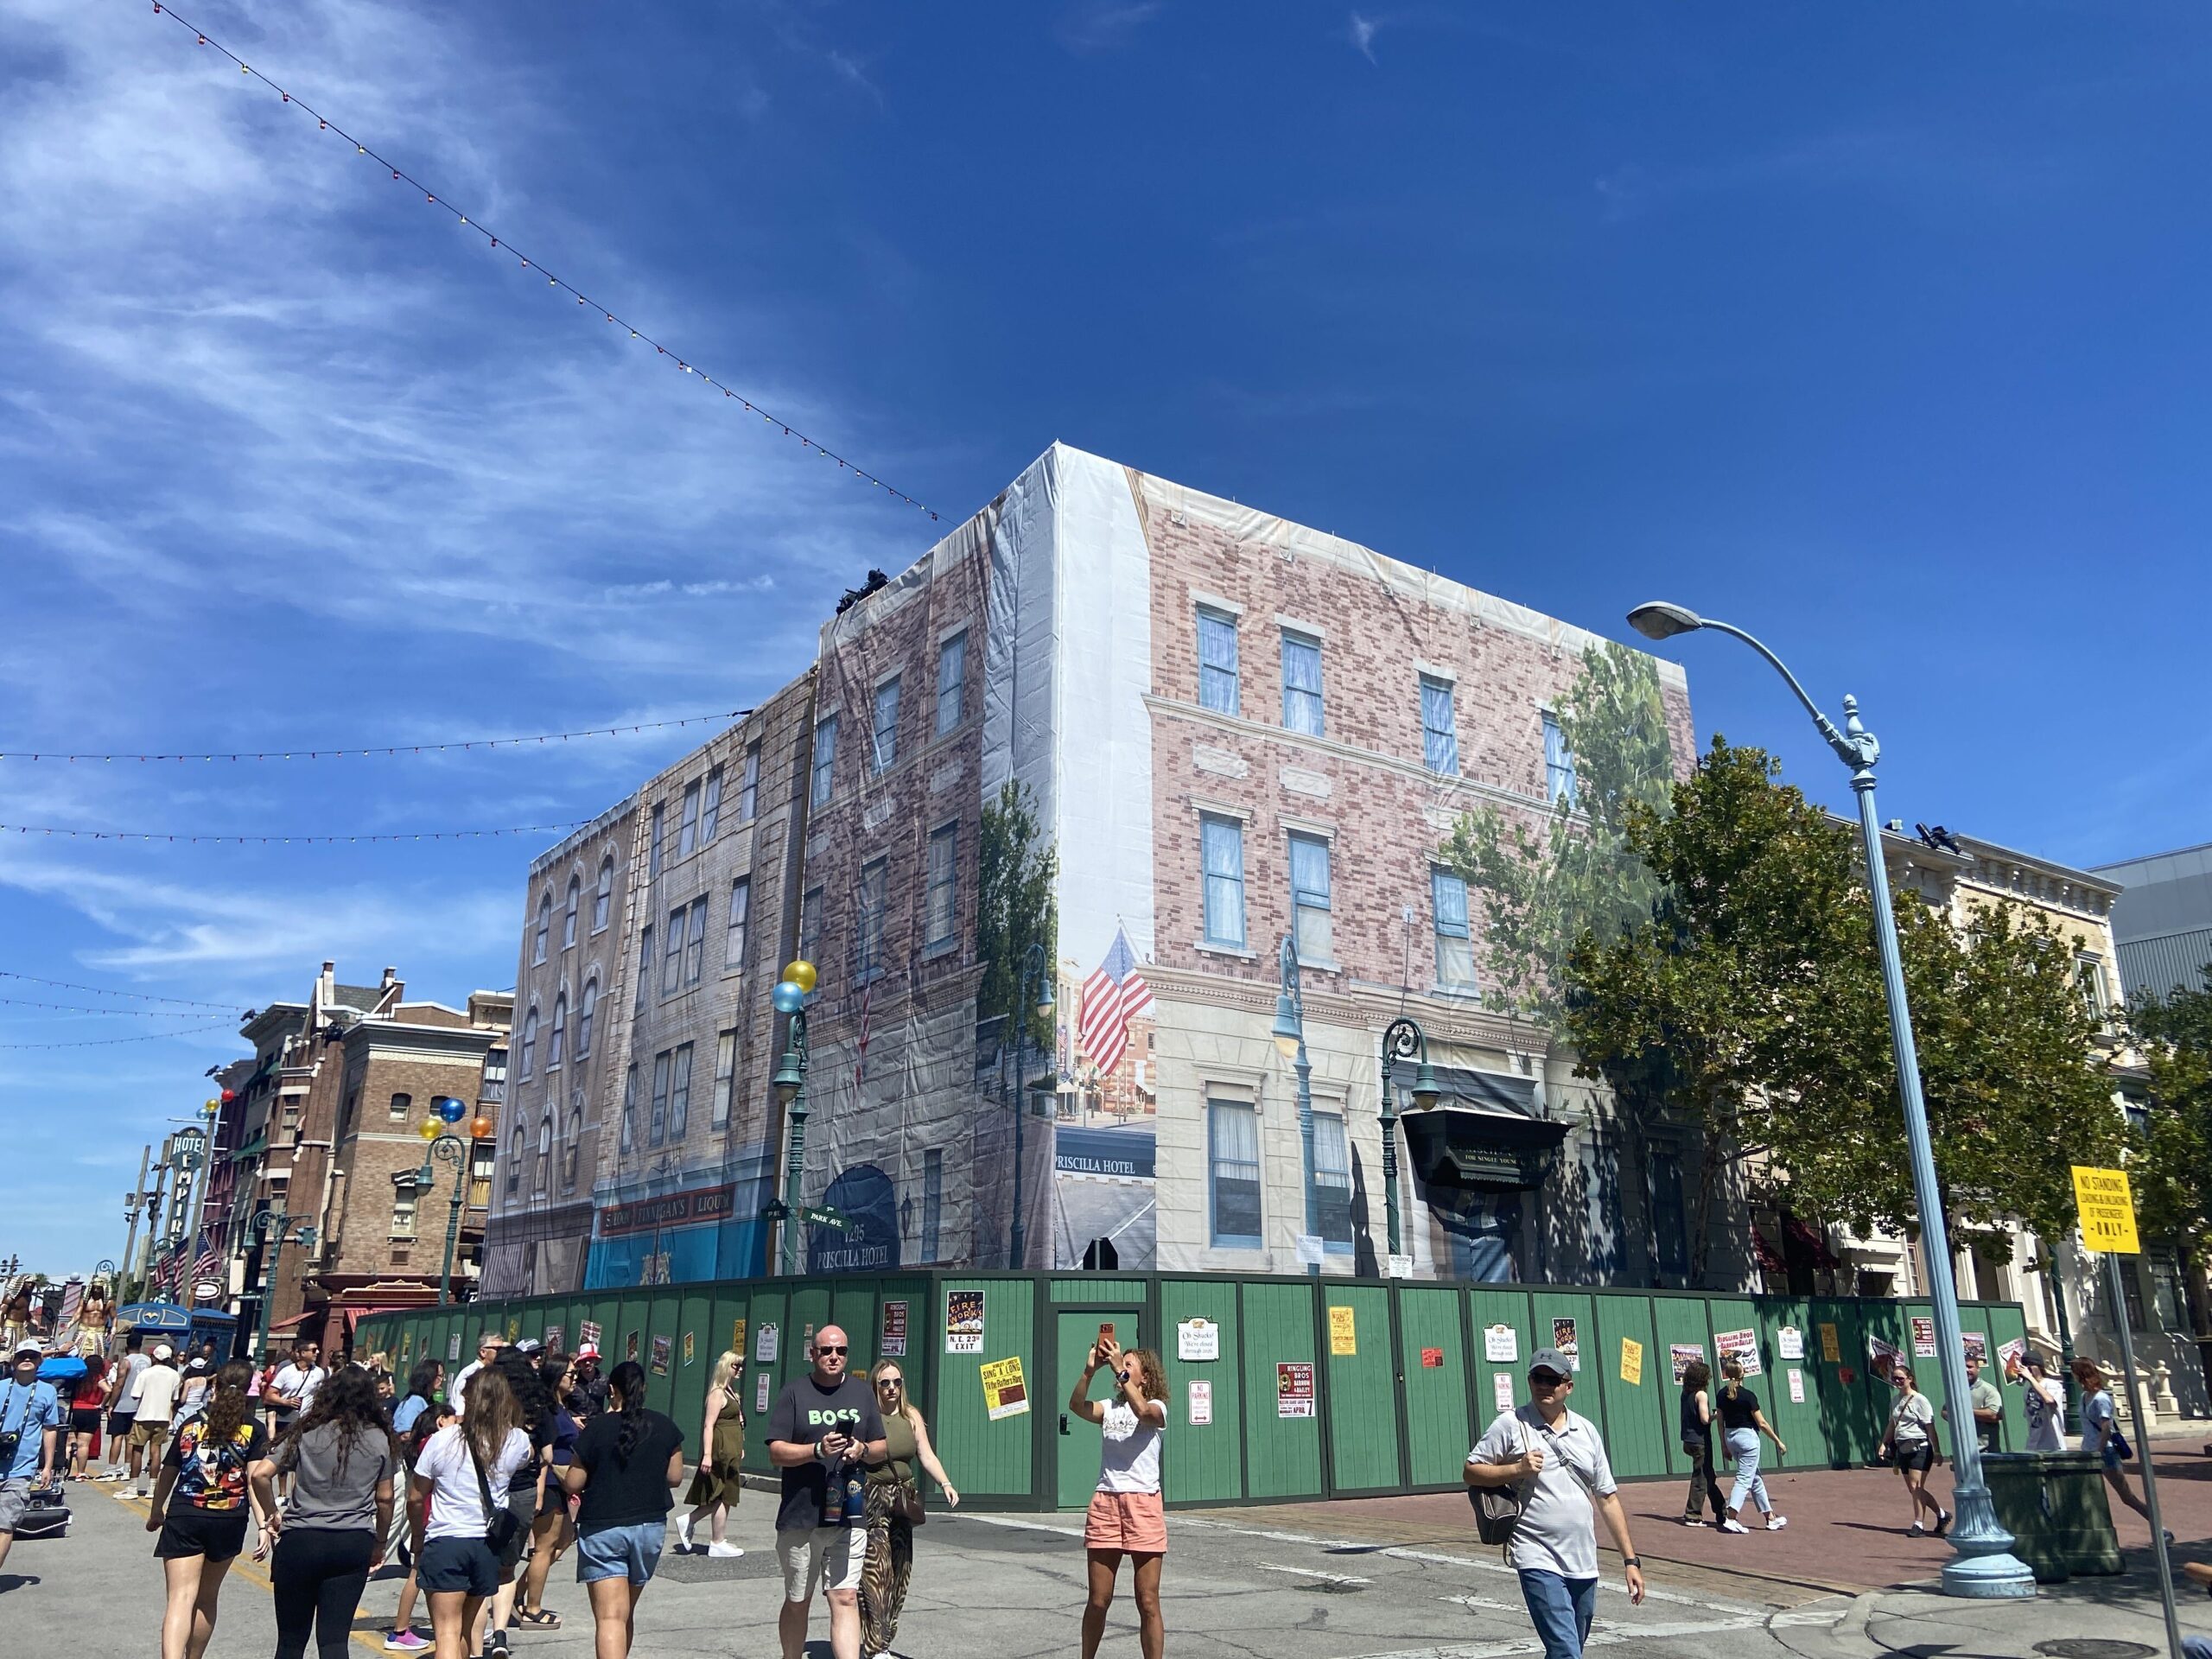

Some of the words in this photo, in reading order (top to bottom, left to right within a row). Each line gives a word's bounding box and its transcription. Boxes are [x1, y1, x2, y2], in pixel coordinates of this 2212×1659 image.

[1103, 1160, 1135, 1174] HOTEL
[2080, 1175, 2090, 1189] NO
[2091, 1177, 2123, 1192] STANDING
[606, 1211, 630, 1228] SLOON
[810, 1212, 828, 1223] PARK
[829, 1218, 842, 1227] AVE.
[817, 1249, 860, 1269] PRISCILLA
[861, 1244, 888, 1267] HOTEL
[950, 1300, 976, 1313] FIRE
[949, 1309, 982, 1325] WORKS
[1555, 1327, 1572, 1338] FIRE
[982, 1369, 997, 1380] SING
[1005, 1363, 1020, 1374] LONG
[1306, 1400, 1313, 1416] 7
[808, 1408, 861, 1426] BOSS
